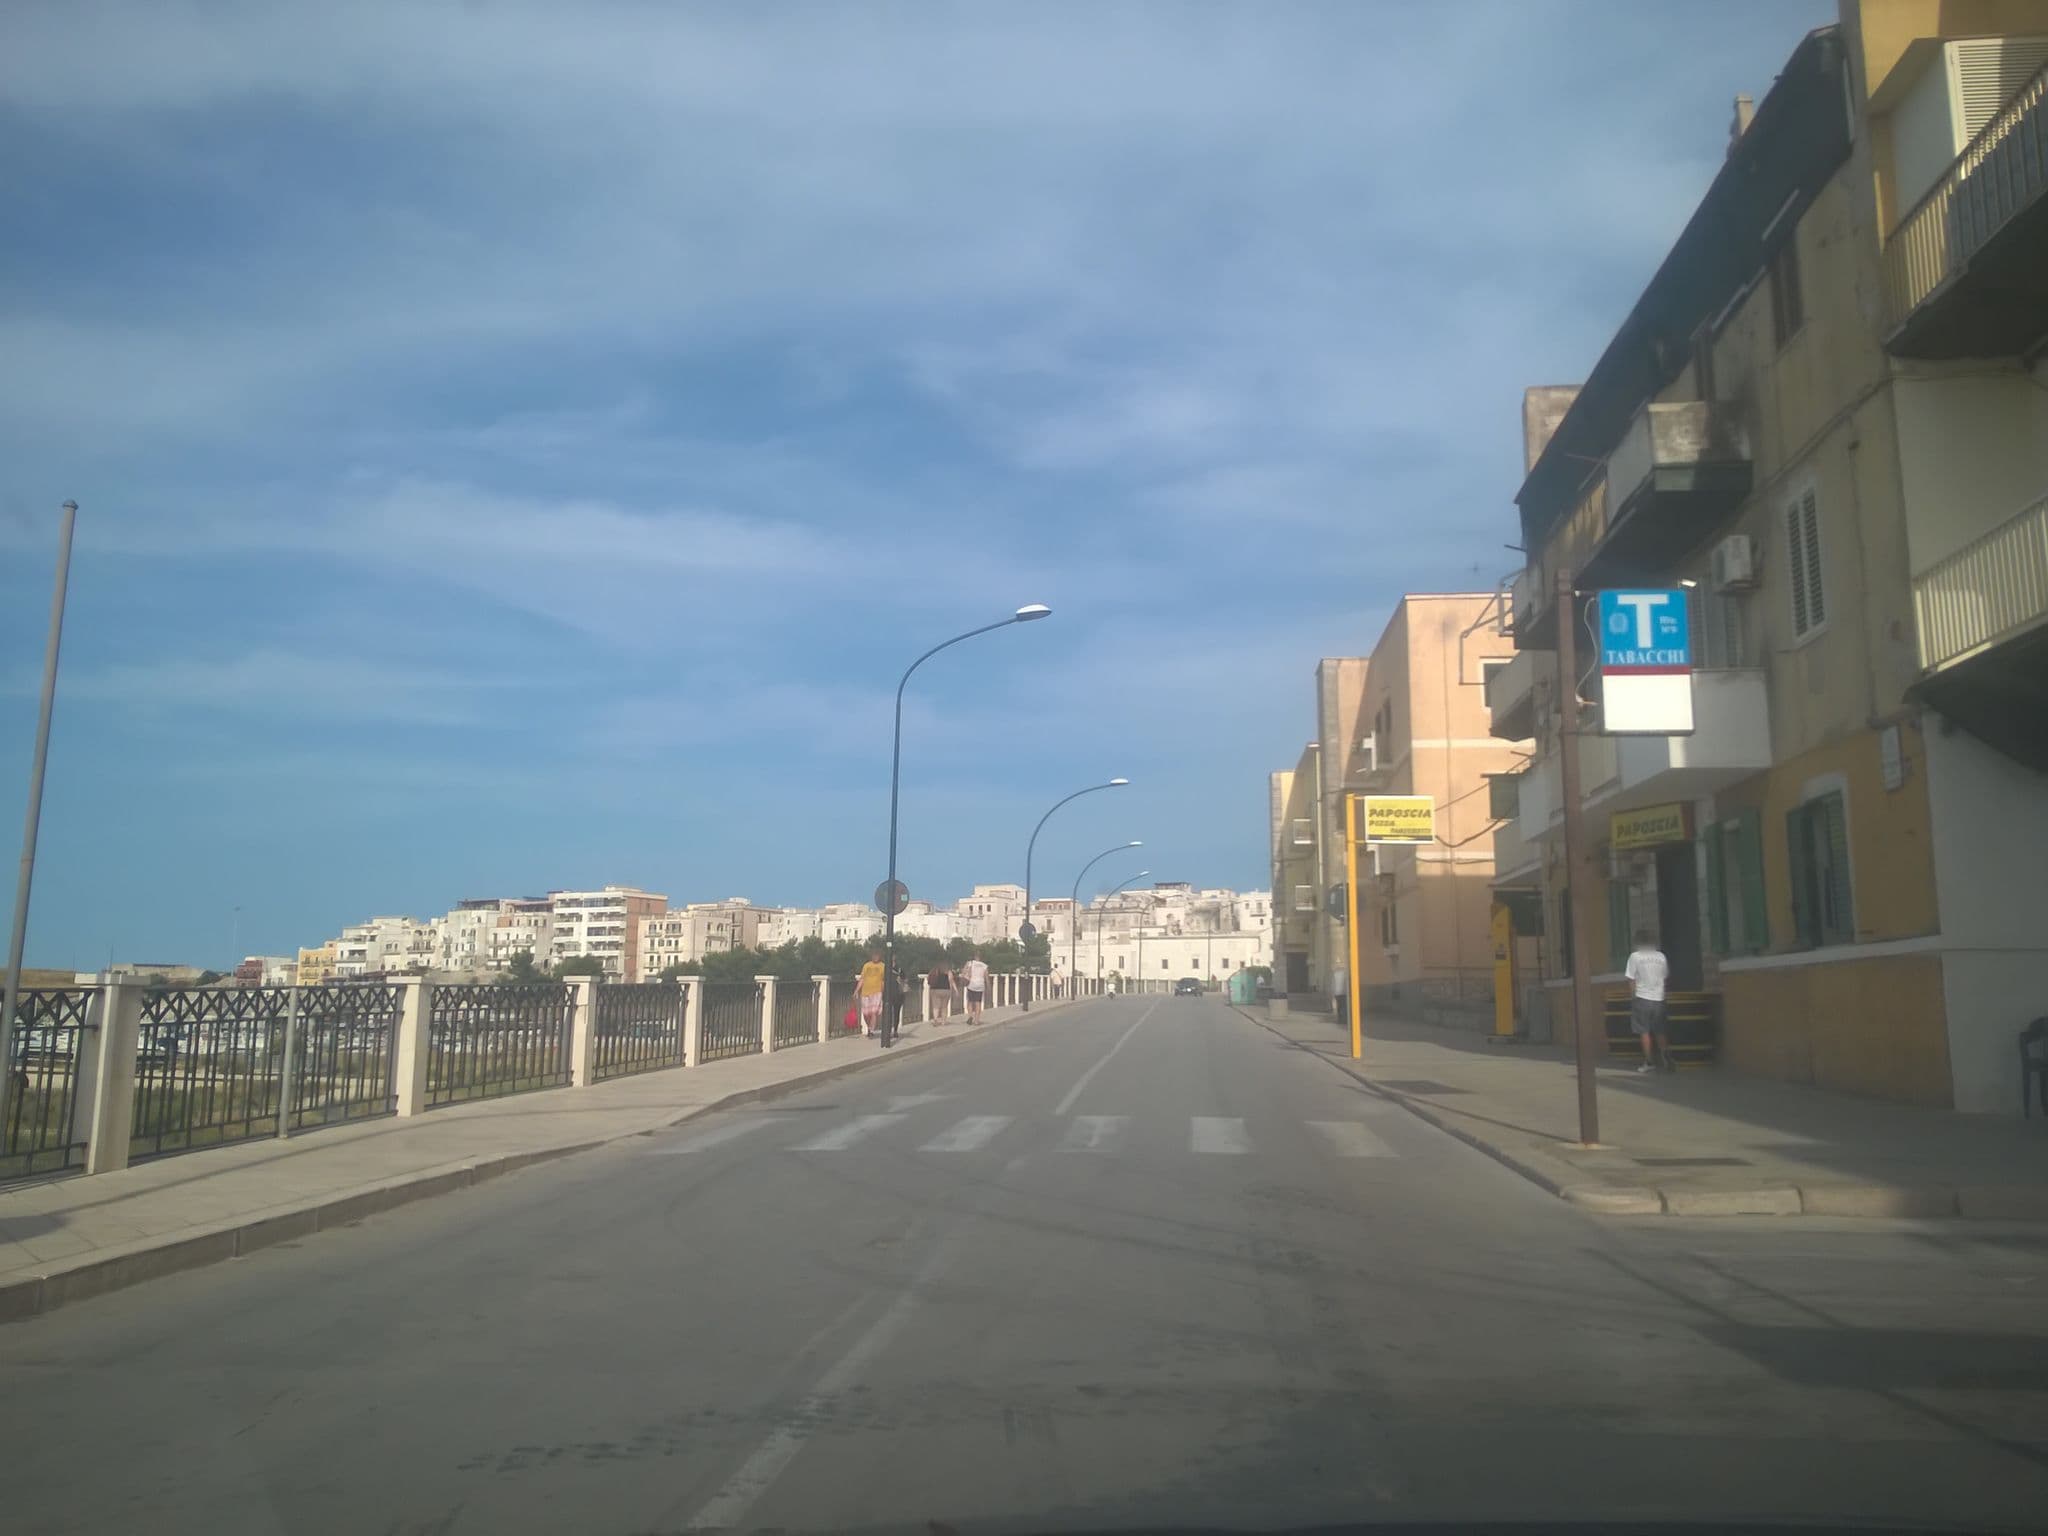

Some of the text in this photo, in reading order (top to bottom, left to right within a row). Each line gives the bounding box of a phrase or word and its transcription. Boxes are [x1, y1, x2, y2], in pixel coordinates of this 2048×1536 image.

[1617, 594, 1669, 648] T
[1607, 650, 1685, 664] TABACCHI
[1368, 809, 1432, 818] PAPOSCIA
[1616, 815, 1680, 839] PAPOSCIA
